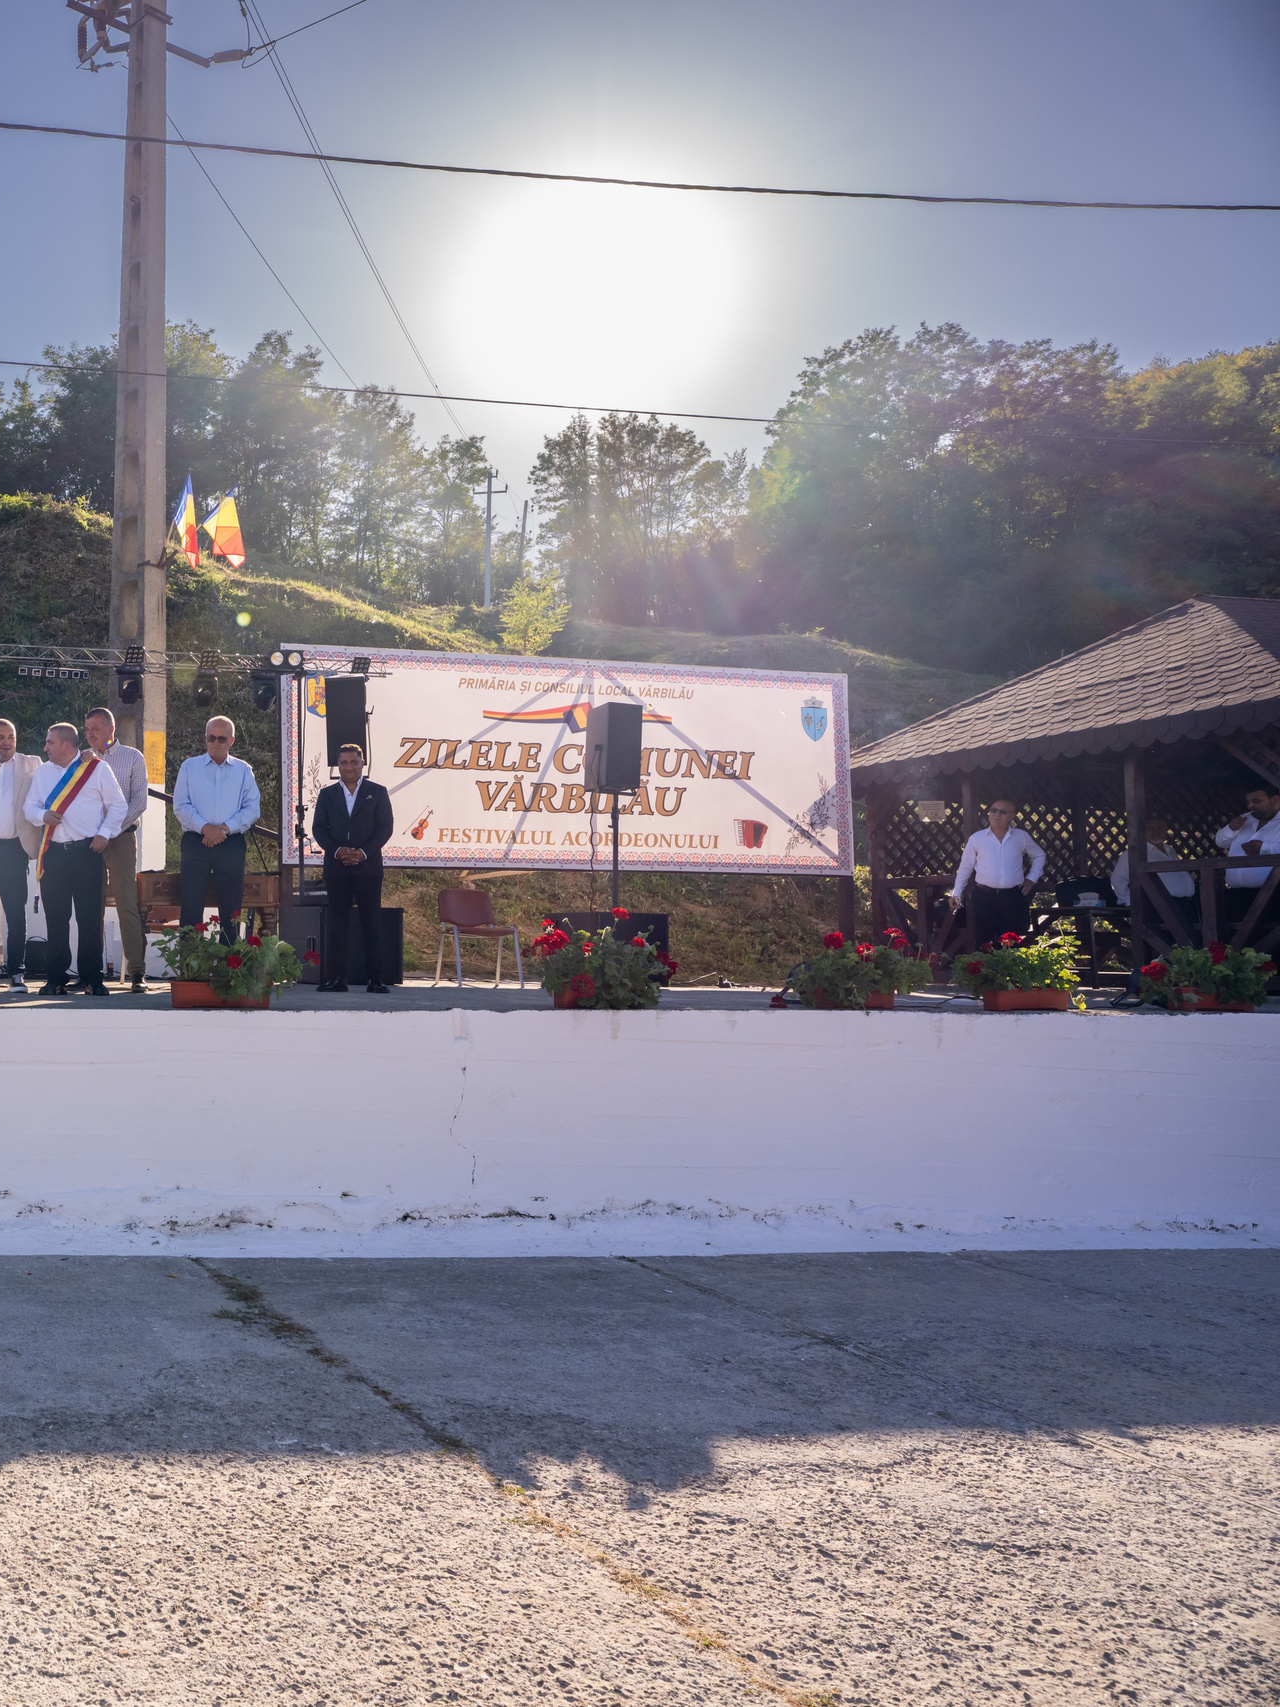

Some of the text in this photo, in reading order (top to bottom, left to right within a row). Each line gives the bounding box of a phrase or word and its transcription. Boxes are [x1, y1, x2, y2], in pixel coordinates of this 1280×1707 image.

[458, 677, 695, 700] PRIMĂRIA ȘI CONSILIUL LOCAL VĂRBILĂU
[393, 737, 755, 780] ZILELE CUNEI
[437, 827, 720, 849] FESTIVALUL ACORDEONULUI
